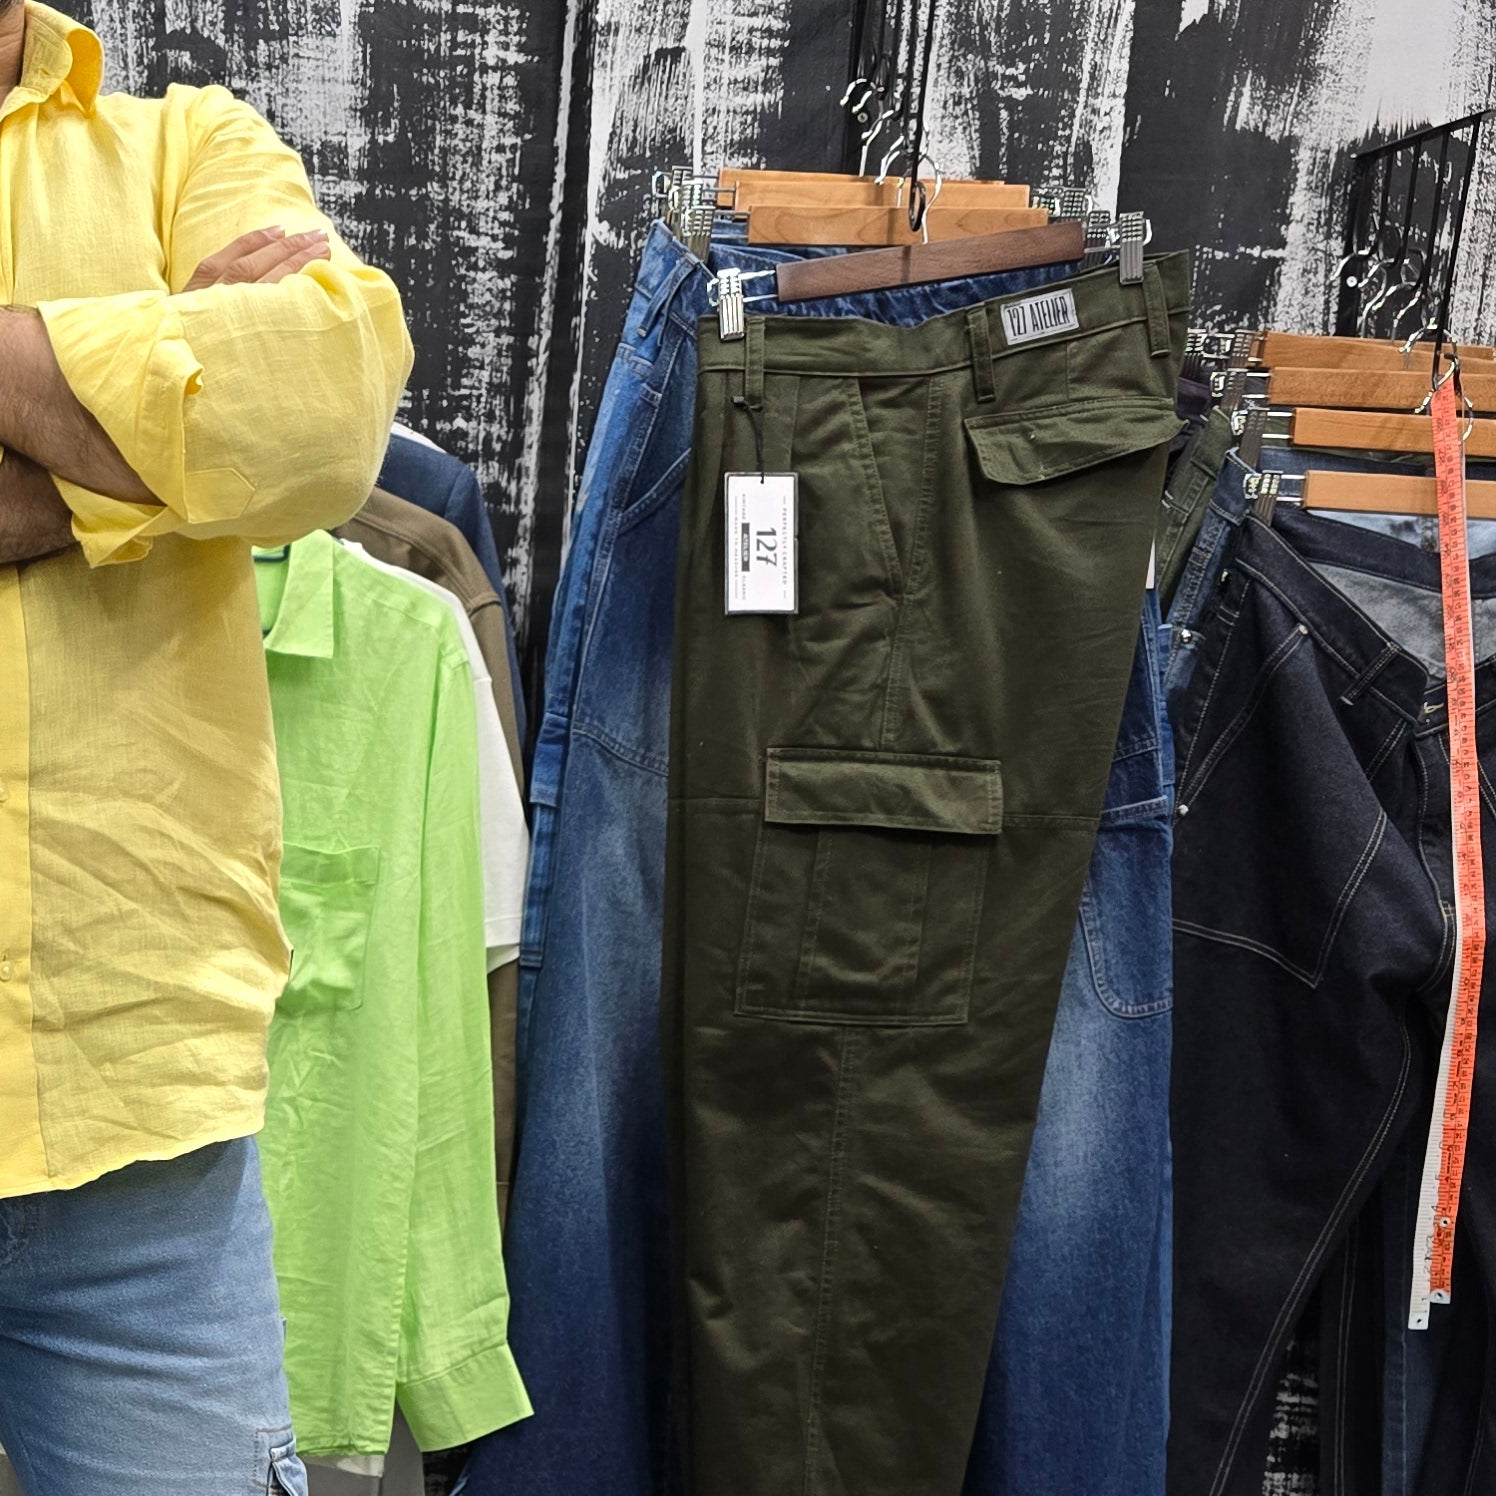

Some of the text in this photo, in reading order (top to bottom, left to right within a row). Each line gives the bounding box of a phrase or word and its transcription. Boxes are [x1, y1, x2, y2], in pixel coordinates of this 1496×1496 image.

[1007, 296, 1070, 337] 127 ATELIER
[756, 527, 778, 567] 127
